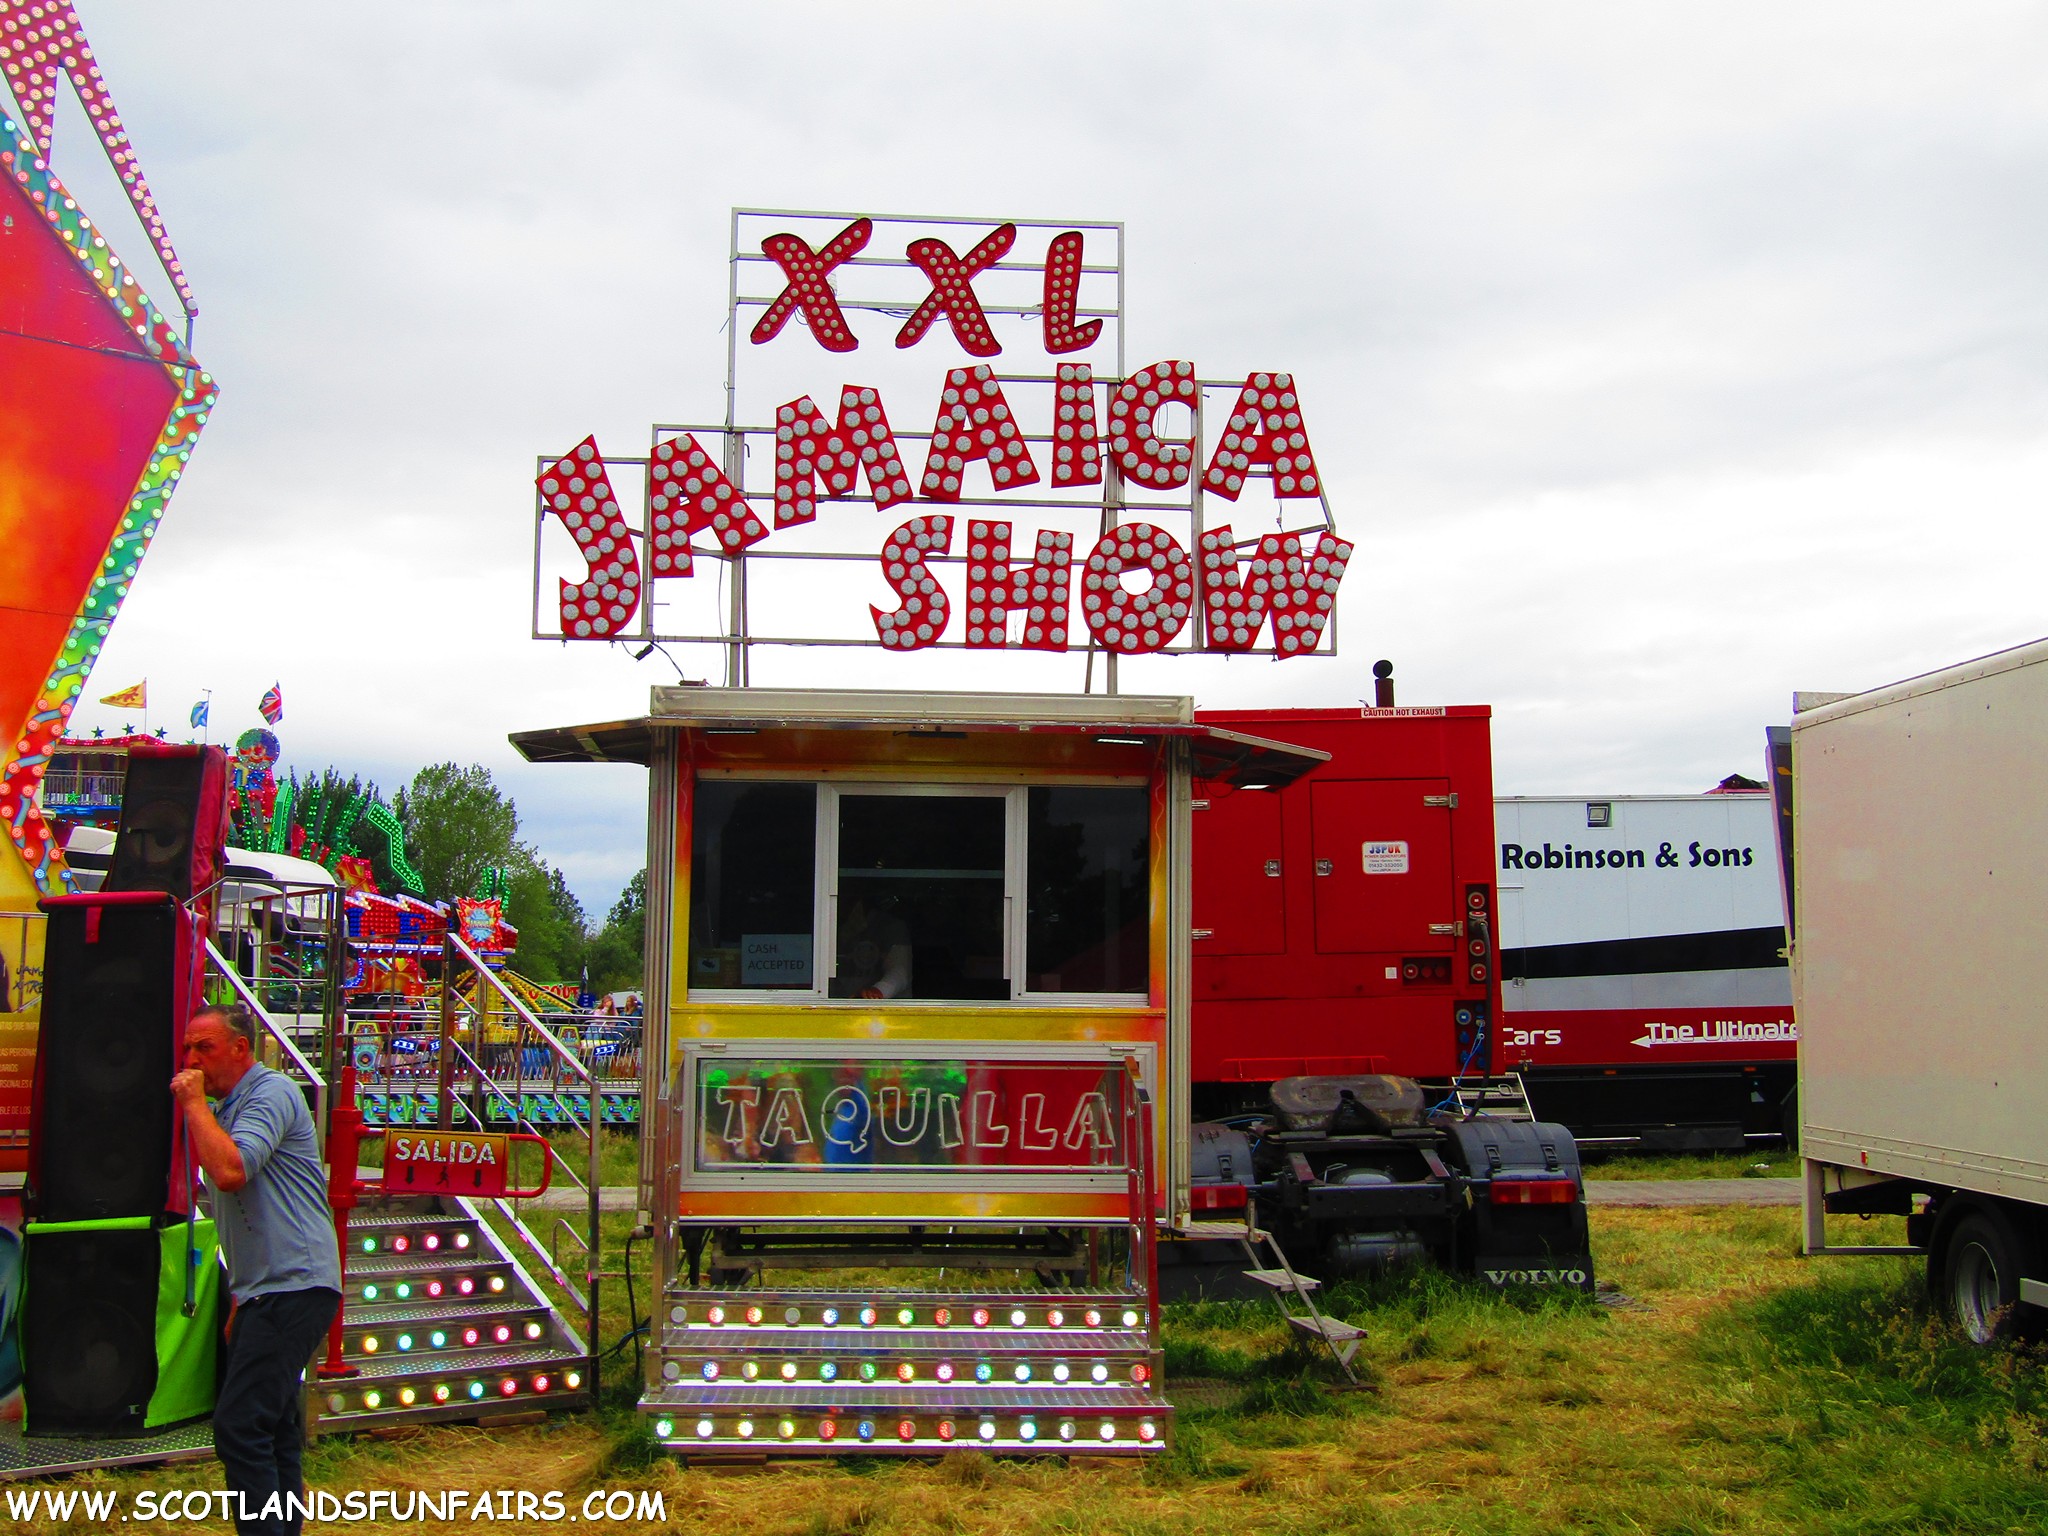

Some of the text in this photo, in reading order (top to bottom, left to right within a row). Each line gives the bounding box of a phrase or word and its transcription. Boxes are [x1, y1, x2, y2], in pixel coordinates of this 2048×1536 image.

[750, 217, 1103, 356] XXL
[535, 360, 1321, 638] JAMAICA
[869, 514, 1355, 659] SHOW
[1363, 707, 1443, 717] CAUTION HOT EXHAUST
[1501, 841, 1753, 869] Robinson & Sons
[747, 944, 777, 954] CASH
[747, 960, 805, 970] ACCEPTED
[1645, 1021, 1694, 1042] The
[716, 1085, 1117, 1154] TAQUILLA
[395, 1138, 496, 1165] SALIDA
[1484, 1269, 1586, 1285] VOLVO
